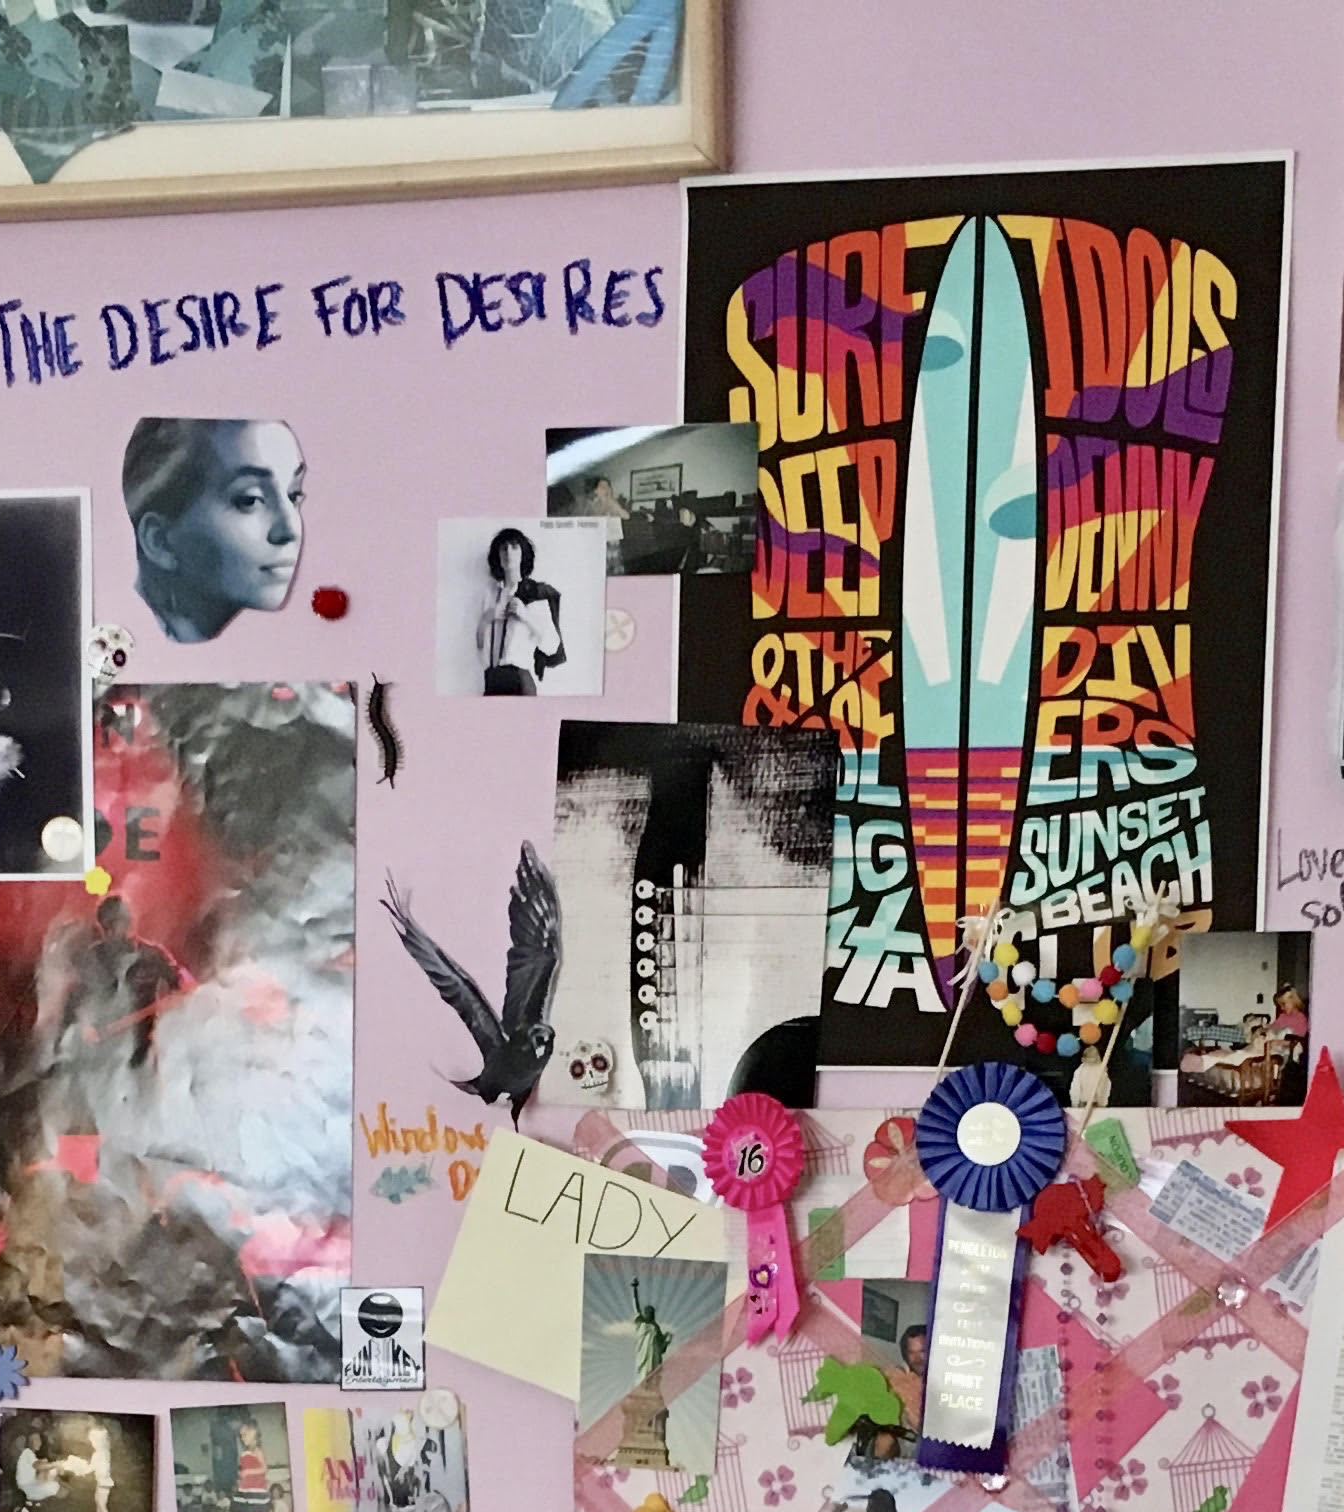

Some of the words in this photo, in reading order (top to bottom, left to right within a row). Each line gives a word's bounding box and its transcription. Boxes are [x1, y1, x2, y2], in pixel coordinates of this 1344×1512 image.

[99, 282, 284, 371] DESIRE
[311, 274, 407, 338] FOR
[435, 257, 665, 351] DESIRES
[727, 215, 966, 451] SURF
[997, 215, 1238, 444] IDOLS
[1044, 433, 1216, 614] DENNY
[1009, 785, 1206, 907] SUNSET
[1039, 820, 1214, 930] BEACH
[504, 1148, 697, 1258] LADY
[735, 1144, 767, 1177] 16
[938, 1392, 985, 1410] PLACE
